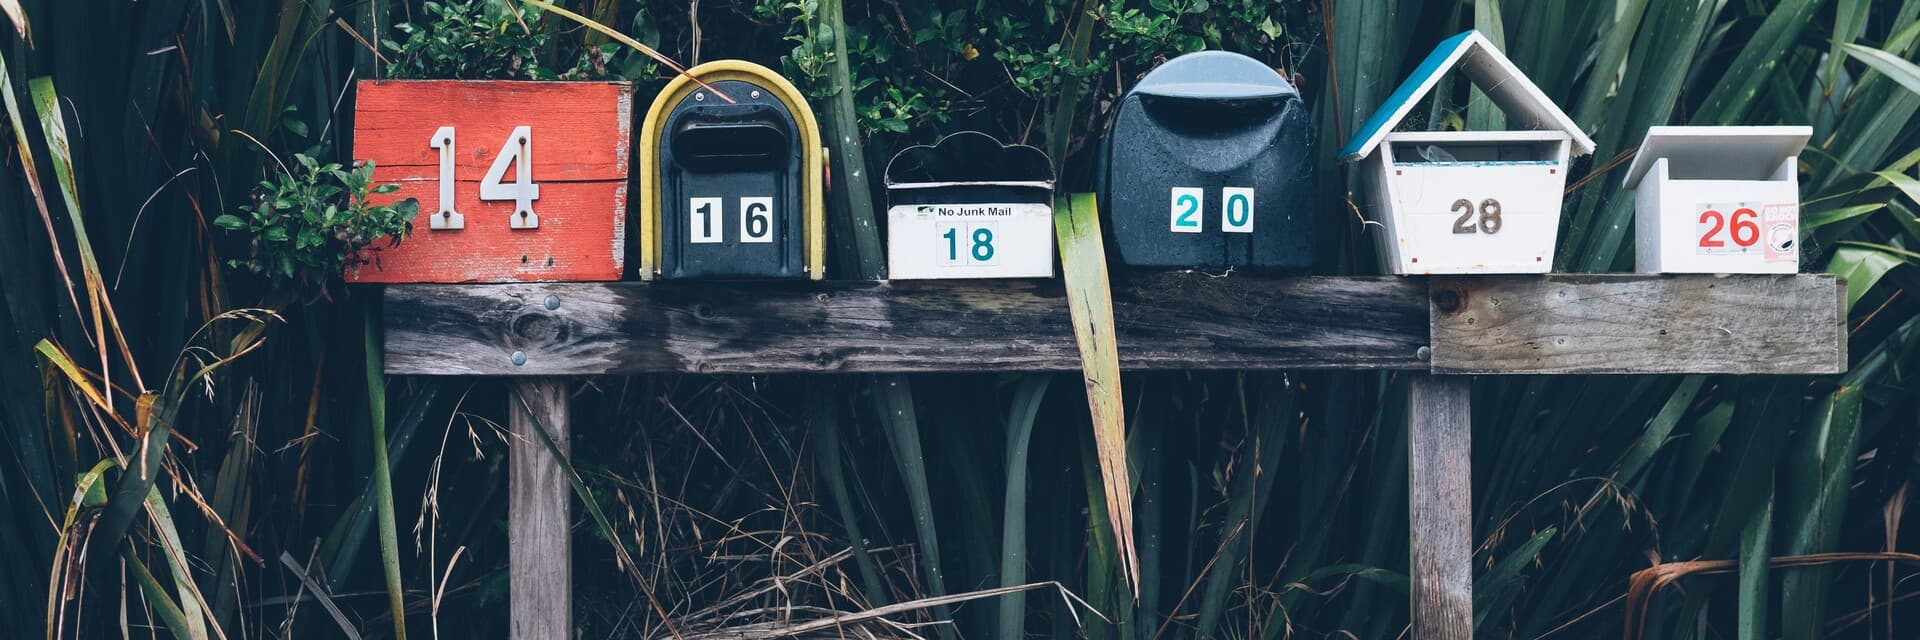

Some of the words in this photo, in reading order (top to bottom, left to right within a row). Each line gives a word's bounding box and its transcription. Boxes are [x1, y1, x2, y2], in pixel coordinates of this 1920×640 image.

[429, 126, 540, 229] 14
[695, 203, 769, 238] 16
[938, 207, 955, 217] No
[957, 207, 986, 217] Junk
[988, 207, 1012, 217] Mail
[1175, 193, 1250, 227] 20
[1450, 198, 1502, 234] 28
[1699, 207, 1760, 248] 26
[943, 227, 995, 262] 18
